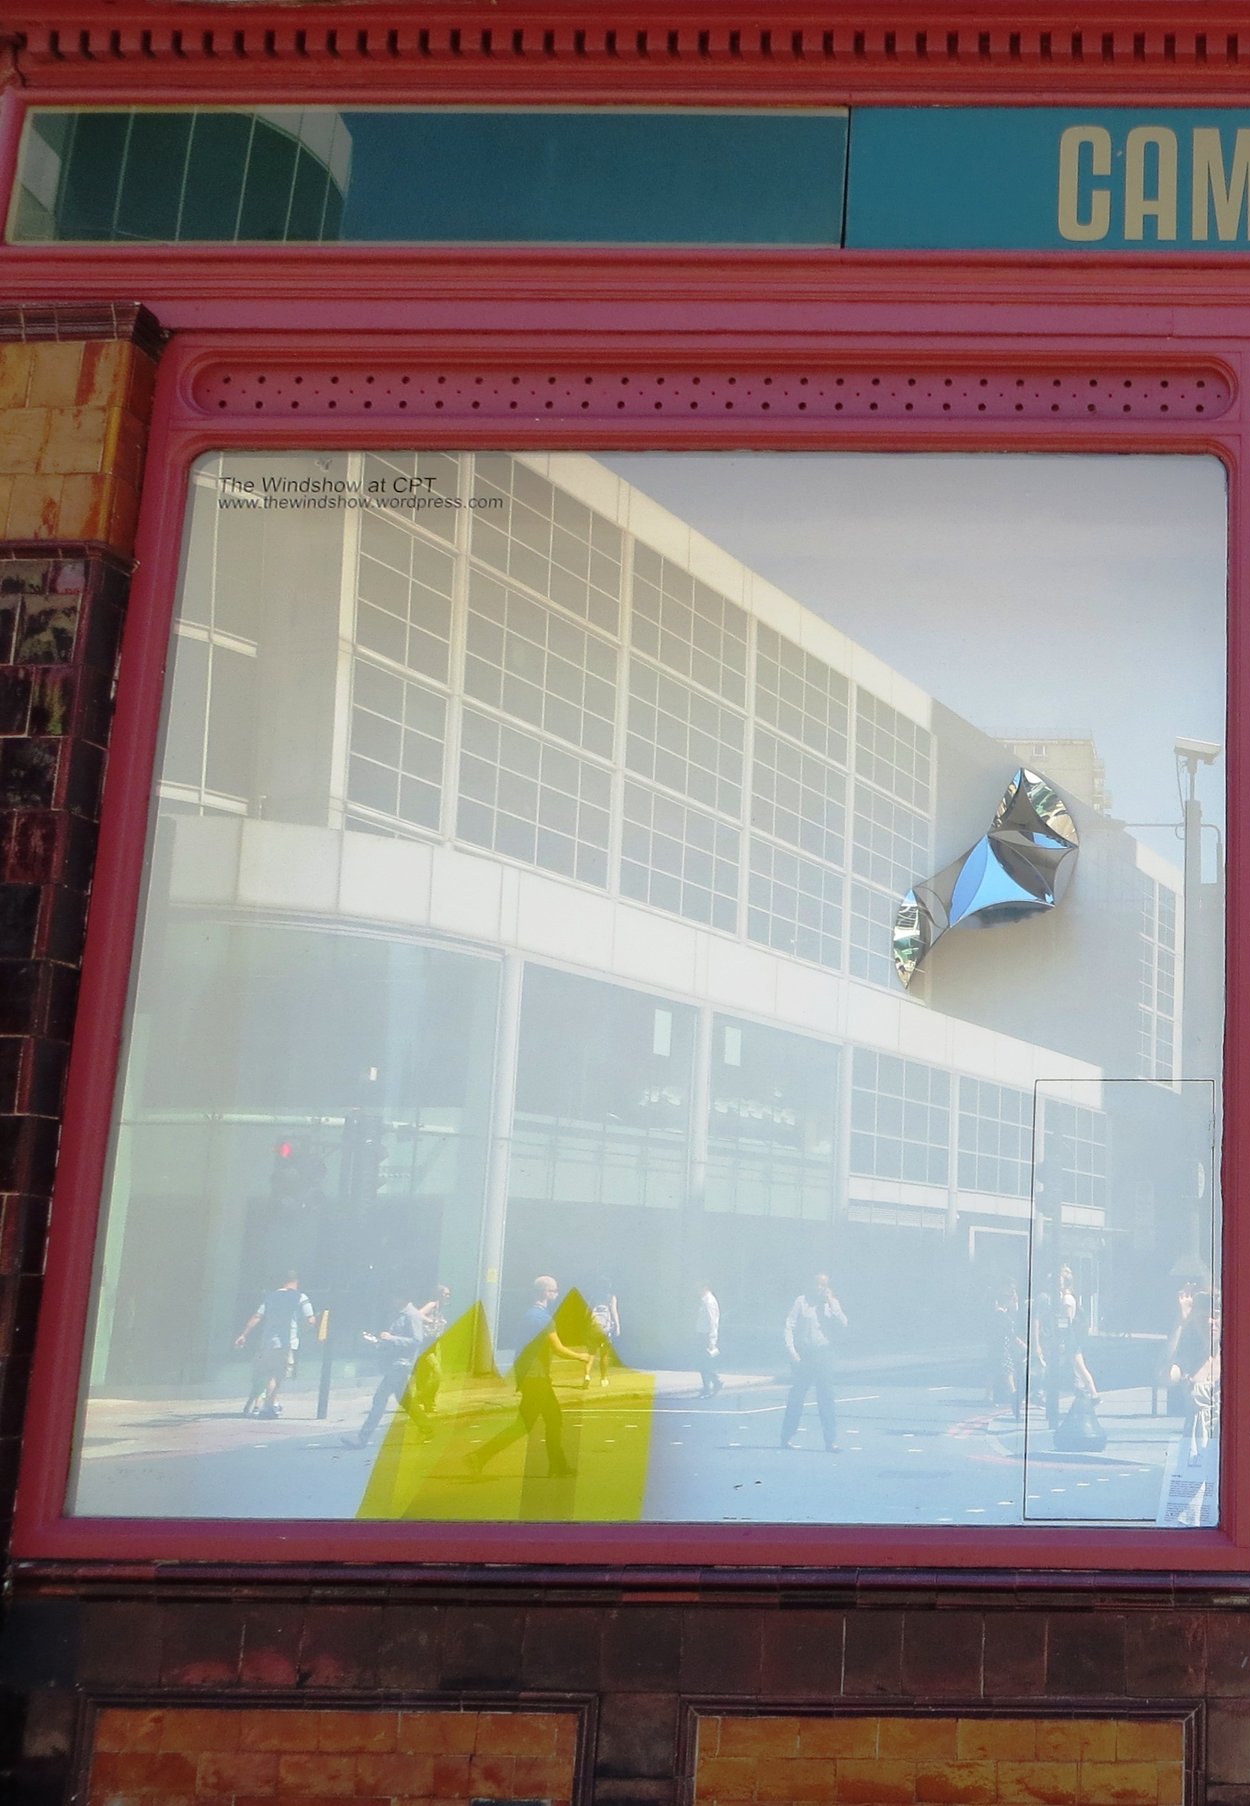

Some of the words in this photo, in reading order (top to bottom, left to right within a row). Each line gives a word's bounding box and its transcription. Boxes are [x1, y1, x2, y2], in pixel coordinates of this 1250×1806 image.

[219, 477, 254, 492] The
[262, 477, 361, 492] Windshow
[368, 478, 386, 493] at
[393, 477, 436, 493] CPT
[218, 495, 503, 511] www.thewindshow.wordpress.com
